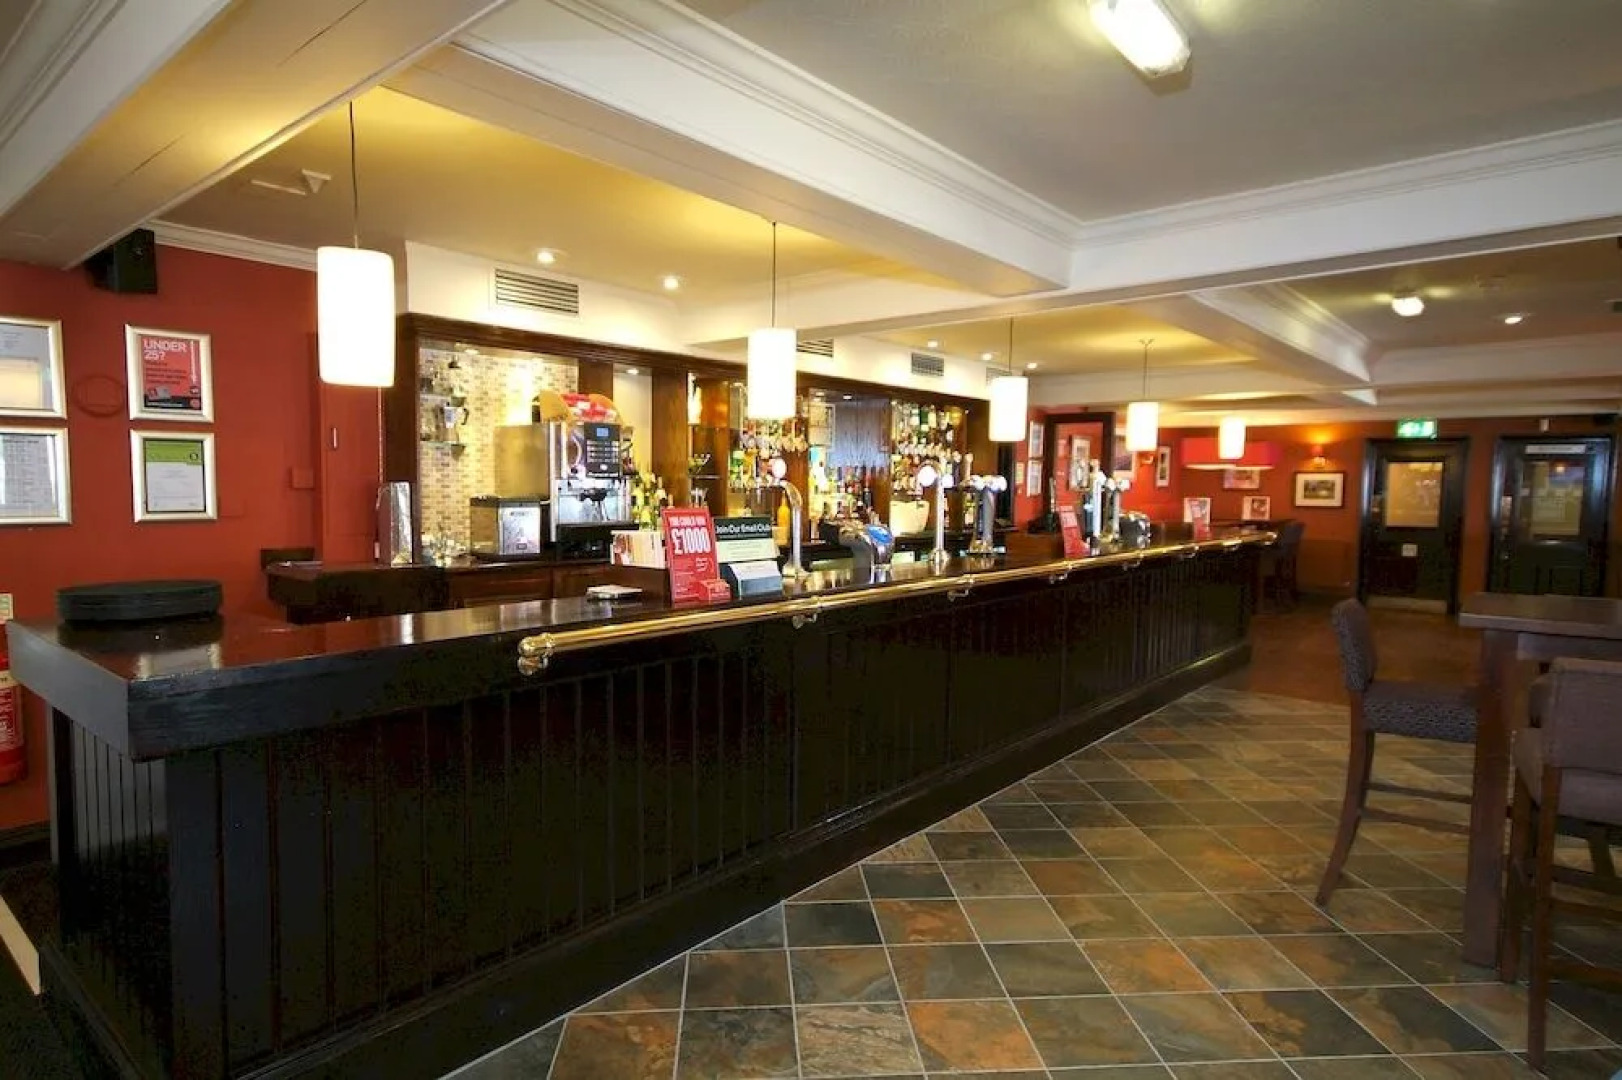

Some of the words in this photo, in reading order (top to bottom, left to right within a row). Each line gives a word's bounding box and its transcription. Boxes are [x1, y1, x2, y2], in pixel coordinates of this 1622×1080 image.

[143, 338, 187, 352] UNDER
[728, 524, 740, 533] Our
[671, 527, 711, 554] £1000
